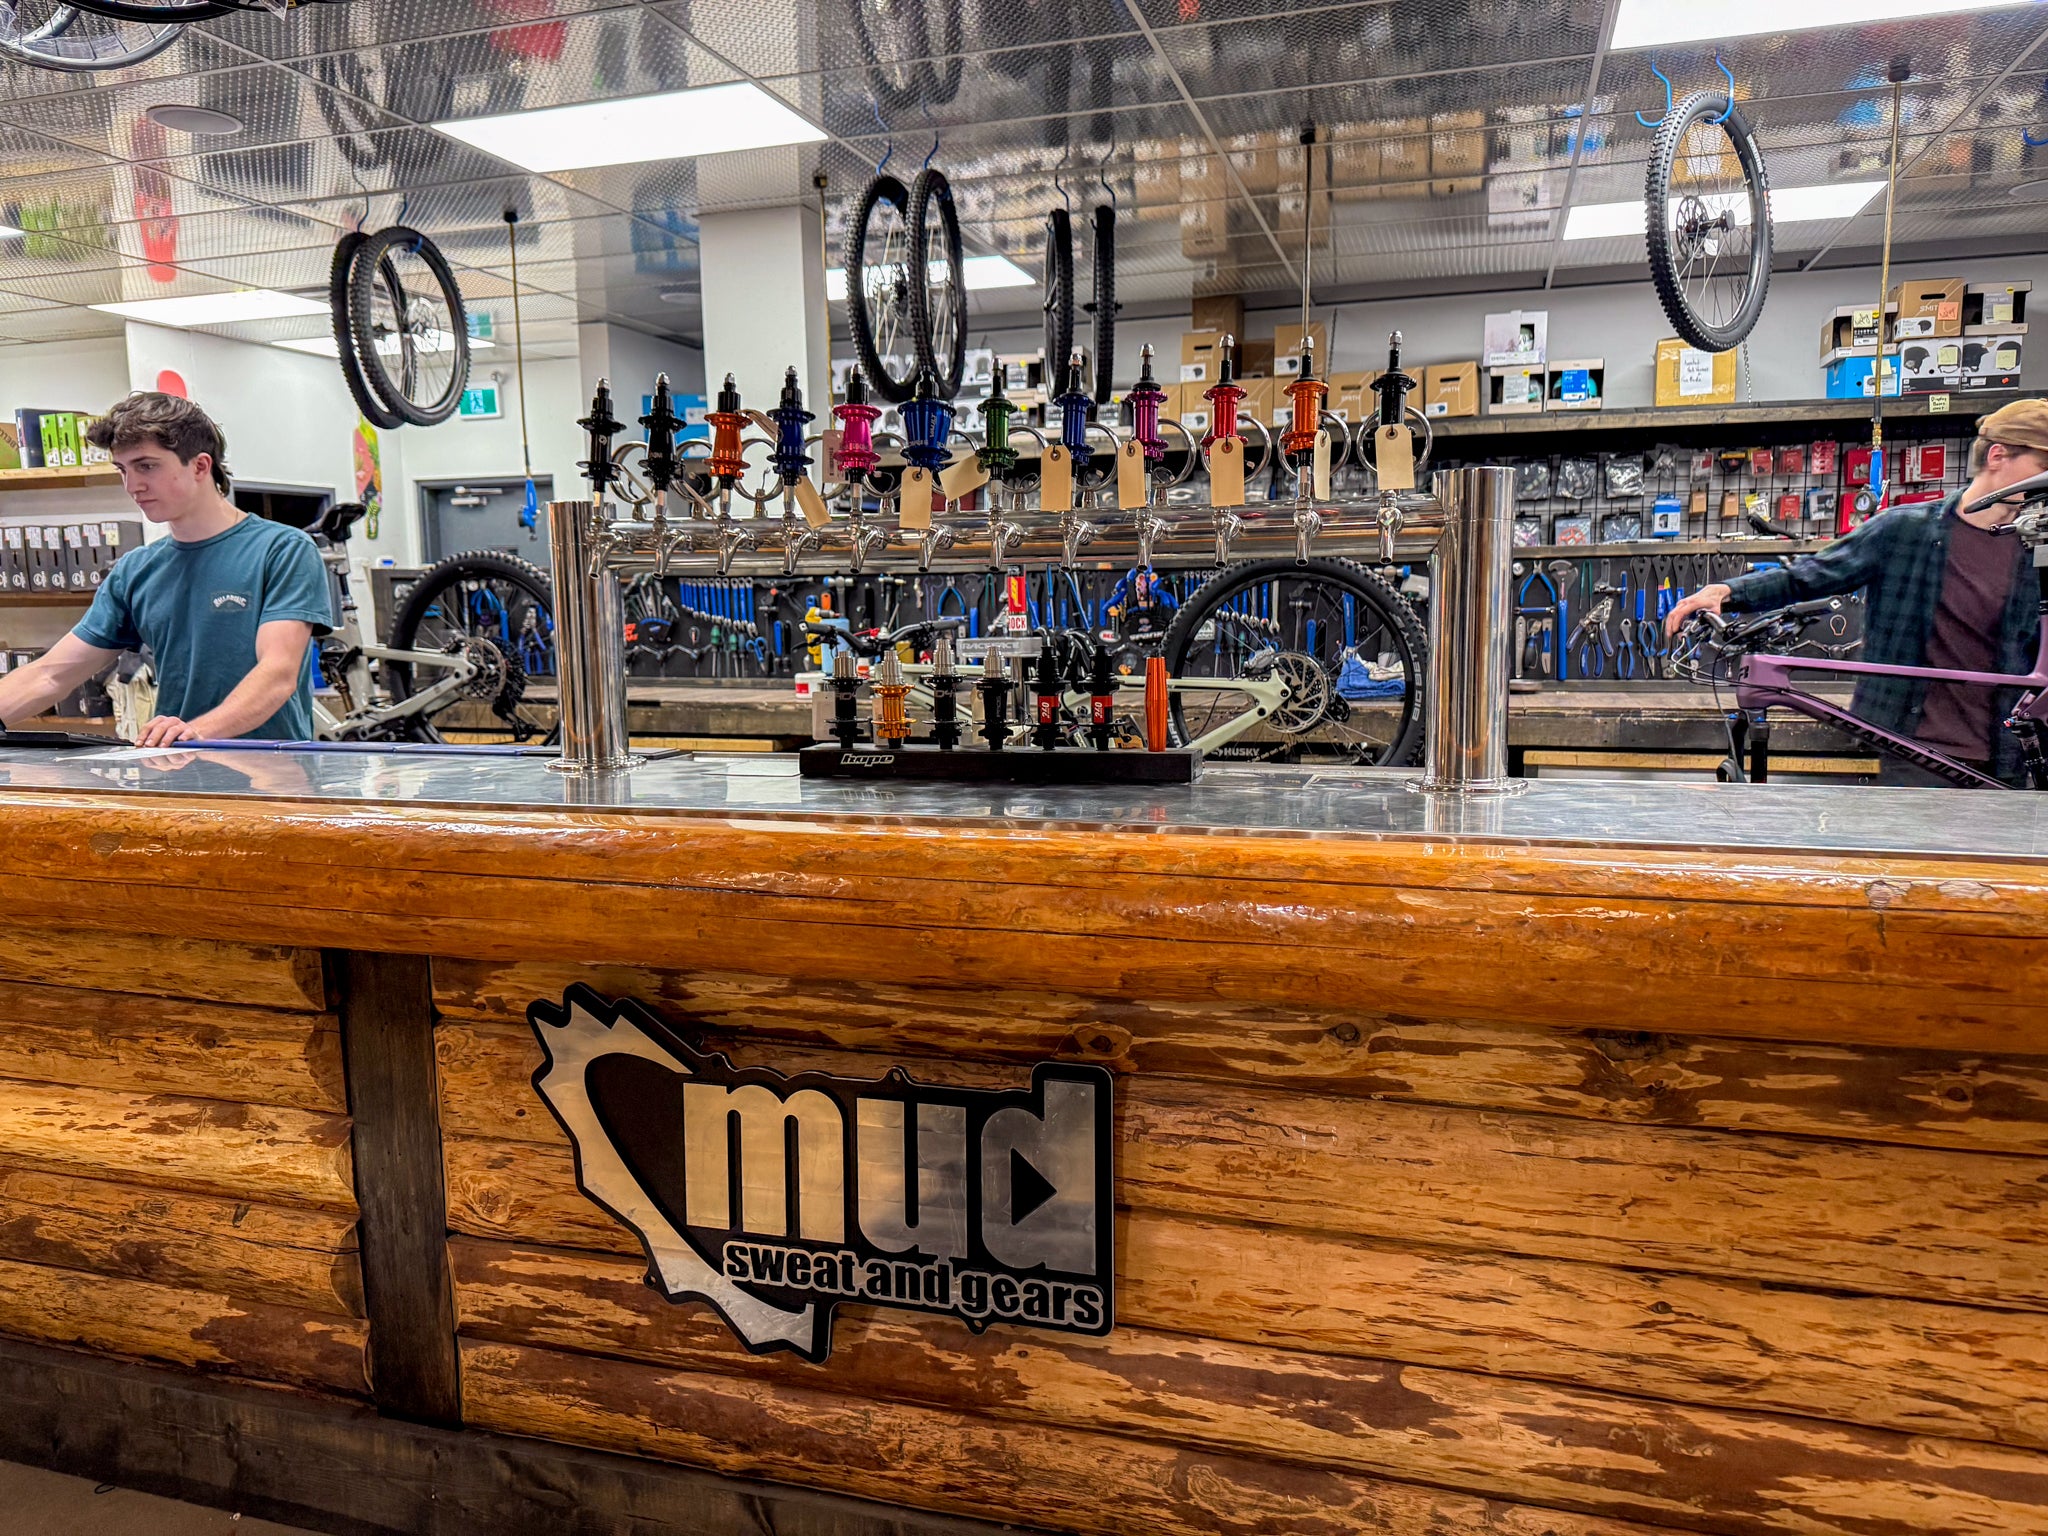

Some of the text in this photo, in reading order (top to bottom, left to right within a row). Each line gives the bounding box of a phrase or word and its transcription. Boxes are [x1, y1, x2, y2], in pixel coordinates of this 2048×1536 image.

[1919, 304, 1939, 312] SMIT
[1223, 747, 1260, 757] HUSKY
[683, 1079, 1097, 1277] mud
[724, 1242, 1104, 1328] sweat and gears
